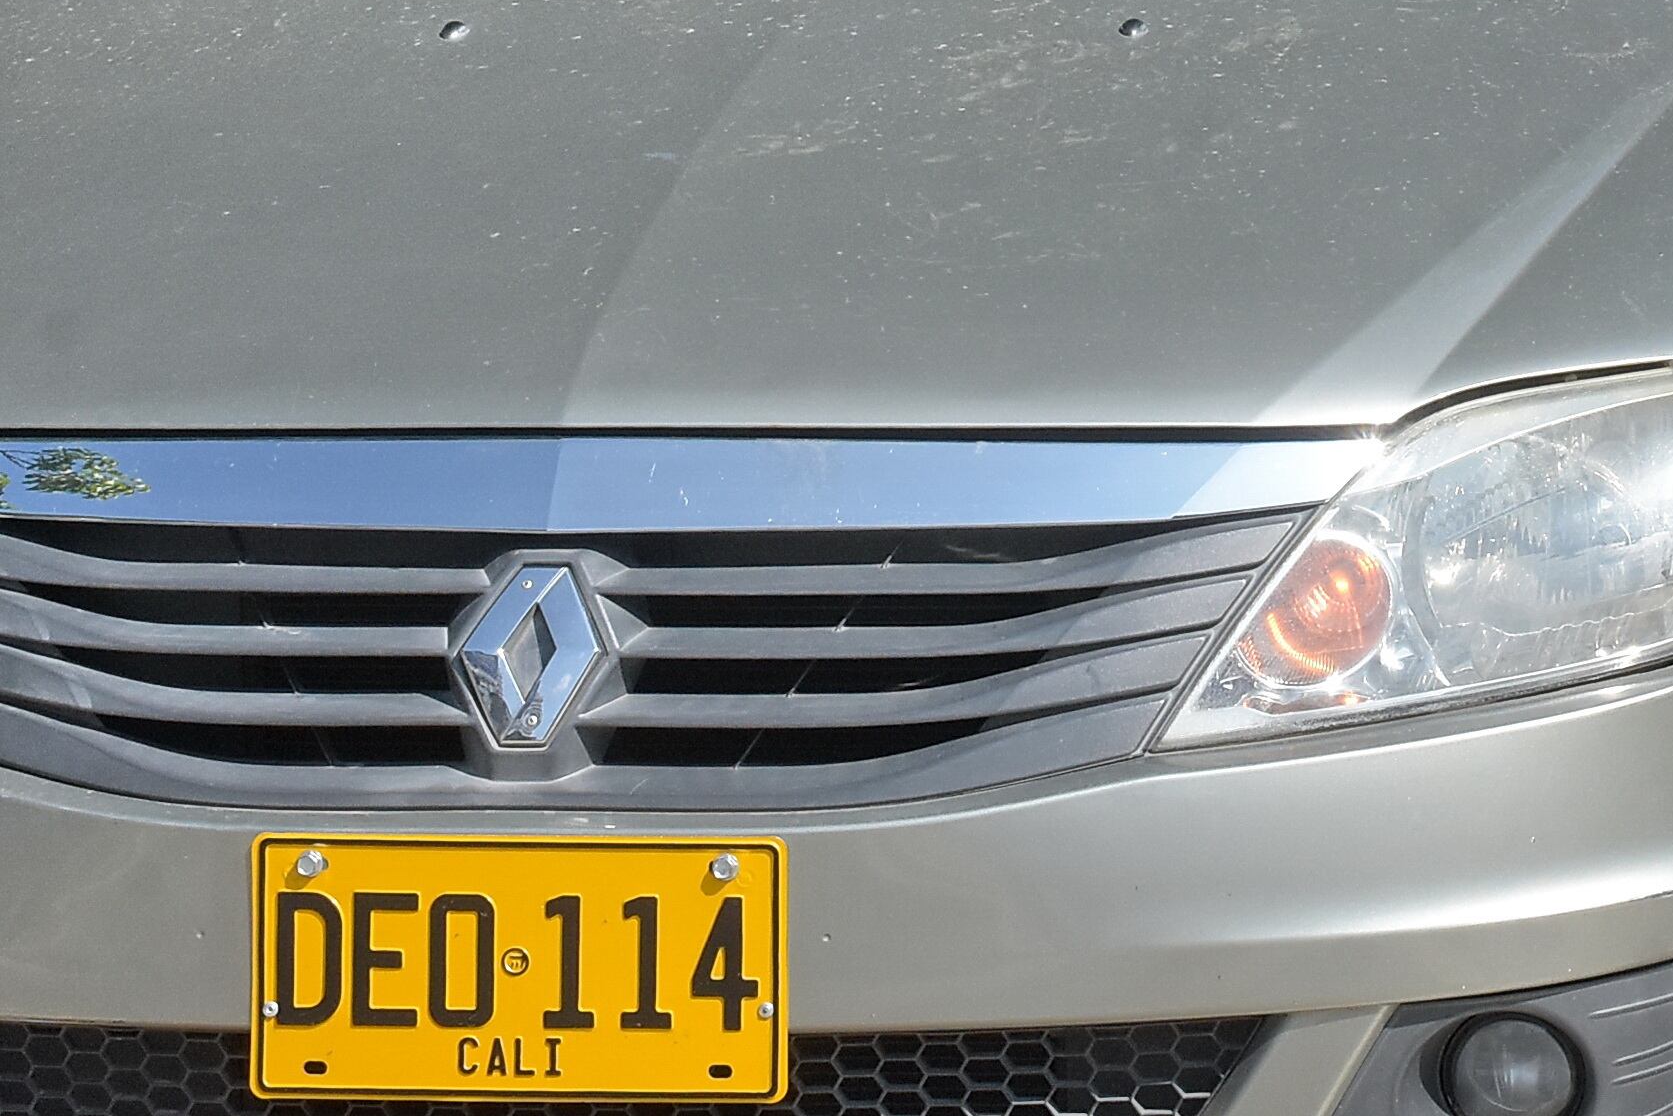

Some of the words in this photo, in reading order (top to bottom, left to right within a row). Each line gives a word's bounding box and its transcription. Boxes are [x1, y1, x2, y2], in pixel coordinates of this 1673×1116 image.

[275, 891, 496, 1028] DEO
[542, 894, 760, 1031] 114
[456, 1037, 563, 1078] CALI
